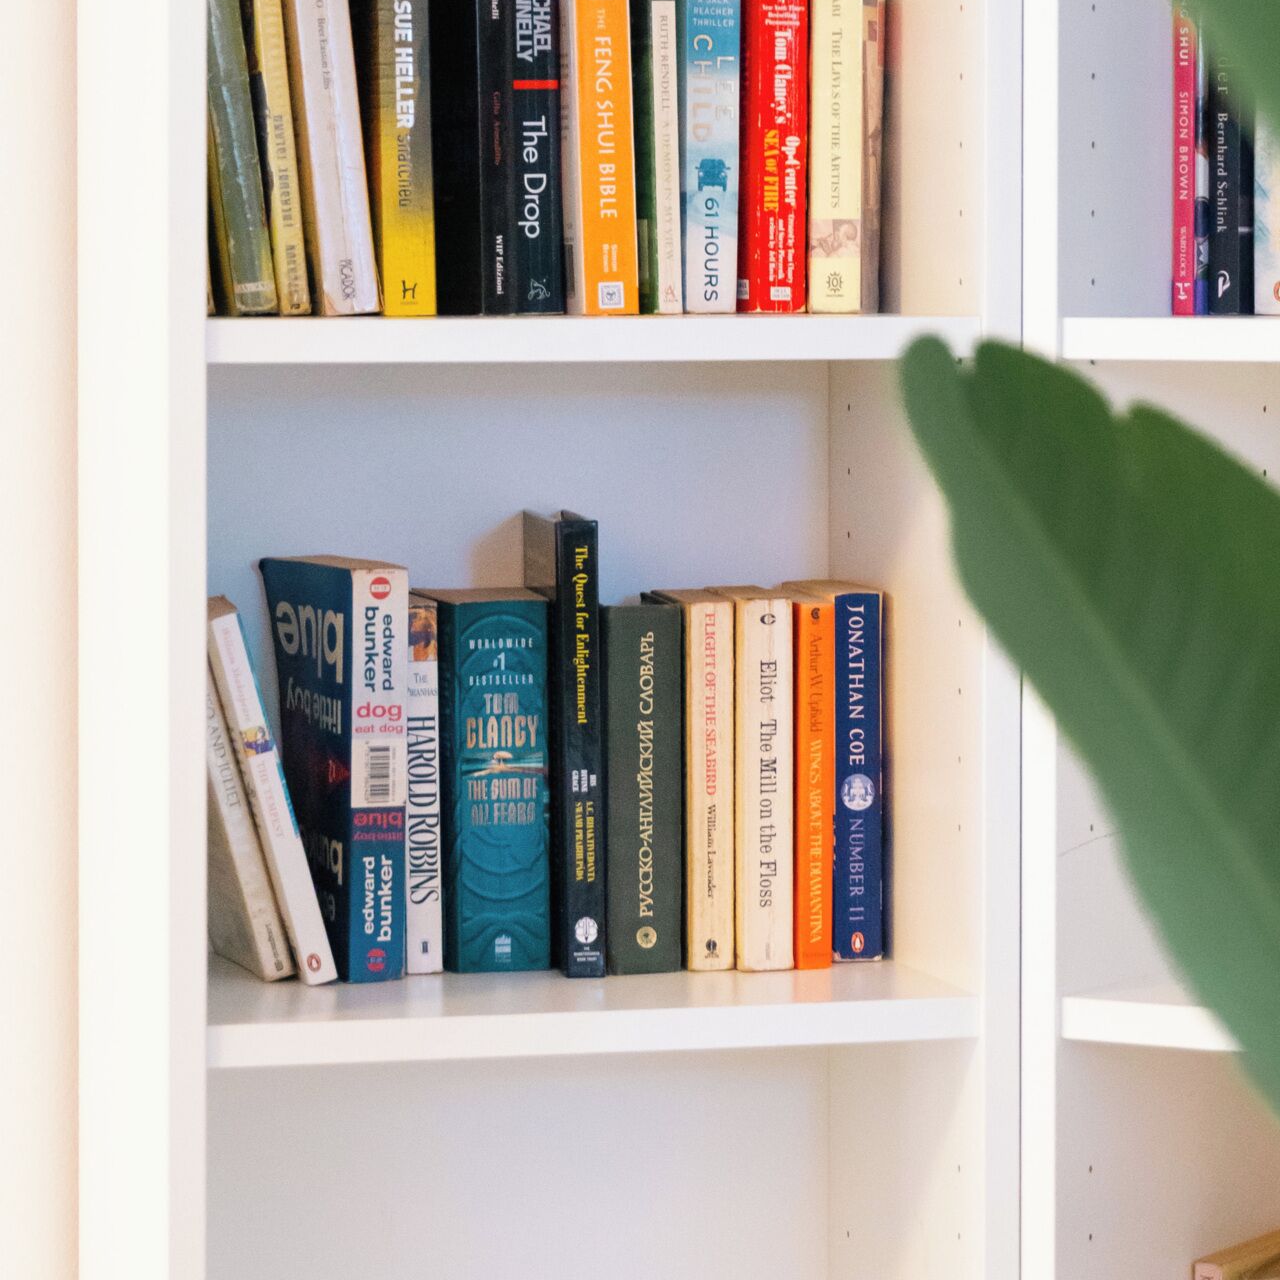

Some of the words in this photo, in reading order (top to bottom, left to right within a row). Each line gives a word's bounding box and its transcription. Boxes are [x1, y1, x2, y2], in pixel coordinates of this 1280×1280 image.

[659, 15, 669, 50] RUTH
[692, 18, 736, 27] THRILLER
[693, 6, 734, 16] REACHER
[595, 36, 613, 93] FENG
[774, 29, 794, 61] Tom
[1179, 26, 1189, 66] SHUI
[395, 47, 415, 129] HELLER
[660, 54, 670, 112] RENDELL
[692, 34, 713, 142] CHILD
[715, 56, 736, 120] LEE
[770, 64, 793, 125] Clancy's
[831, 59, 842, 100] LIVES
[596, 101, 616, 154] SHUI
[831, 123, 841, 151] THE
[1179, 91, 1189, 139] SIMON
[522, 114, 548, 163] The
[661, 133, 672, 183] DEMON
[763, 129, 780, 156] SEA
[1217, 112, 1229, 176] Bernhard
[599, 163, 618, 218] BIBLE
[763, 176, 779, 212] FIRE
[831, 154, 841, 209] ARTISTS
[1178, 146, 1189, 200] BROWN
[517, 173, 547, 239] Drop
[704, 197, 720, 218] 61
[1216, 181, 1228, 233] Schlink
[339, 258, 356, 300] PICADOR
[496, 256, 504, 295] Edizioni
[703, 225, 720, 302] HOURS
[574, 545, 588, 570] The
[572, 573, 588, 608] Quest
[275, 600, 345, 685] blue
[468, 637, 534, 649] WORLDWIDE
[575, 612, 590, 631] for
[704, 613, 716, 670] FLIGHT
[364, 606, 379, 693] bunker
[382, 613, 396, 692] edward
[809, 632, 823, 673] Arthur
[846, 604, 865, 720] JONATHAN
[468, 673, 534, 686] BESTSELLER
[572, 633, 590, 725] Enlightenment
[639, 631, 655, 715] СЛОВАРЬ
[704, 672, 716, 693] OF
[760, 659, 777, 703] Eliot
[356, 702, 402, 721] dog
[482, 692, 520, 715] TOM
[704, 694, 716, 718] THE
[807, 690, 823, 733] Upfield
[210, 725, 227, 760] AND
[355, 723, 376, 734] eat
[380, 722, 403, 734] dog
[465, 715, 539, 749] CLANCY
[759, 719, 777, 753] The
[849, 727, 865, 766] COE
[407, 715, 437, 808] HAROLD
[705, 719, 717, 797] SEABIRD
[759, 758, 777, 795] Mill
[809, 738, 822, 784] WINGS
[218, 760, 241, 808] JULIET
[467, 779, 488, 801] THE
[490, 778, 521, 800] SUM
[523, 777, 537, 798] OF
[353, 811, 403, 828] blue
[471, 803, 490, 827] ALL
[493, 802, 536, 826] FEARS
[638, 720, 654, 918] РУССКО-АНГЛИЙСКИЙ
[706, 804, 717, 849] William
[759, 799, 773, 819] on
[809, 786, 823, 830] ABOVE
[408, 813, 440, 905] ROBBINS
[759, 823, 777, 854] the
[810, 832, 822, 860] THE
[848, 818, 865, 897] NUMBER
[362, 856, 375, 935] edward
[706, 850, 717, 900] Lavender
[759, 859, 777, 908] Floss
[377, 853, 393, 942] bunker
[809, 860, 823, 944] DIAMANTINA
